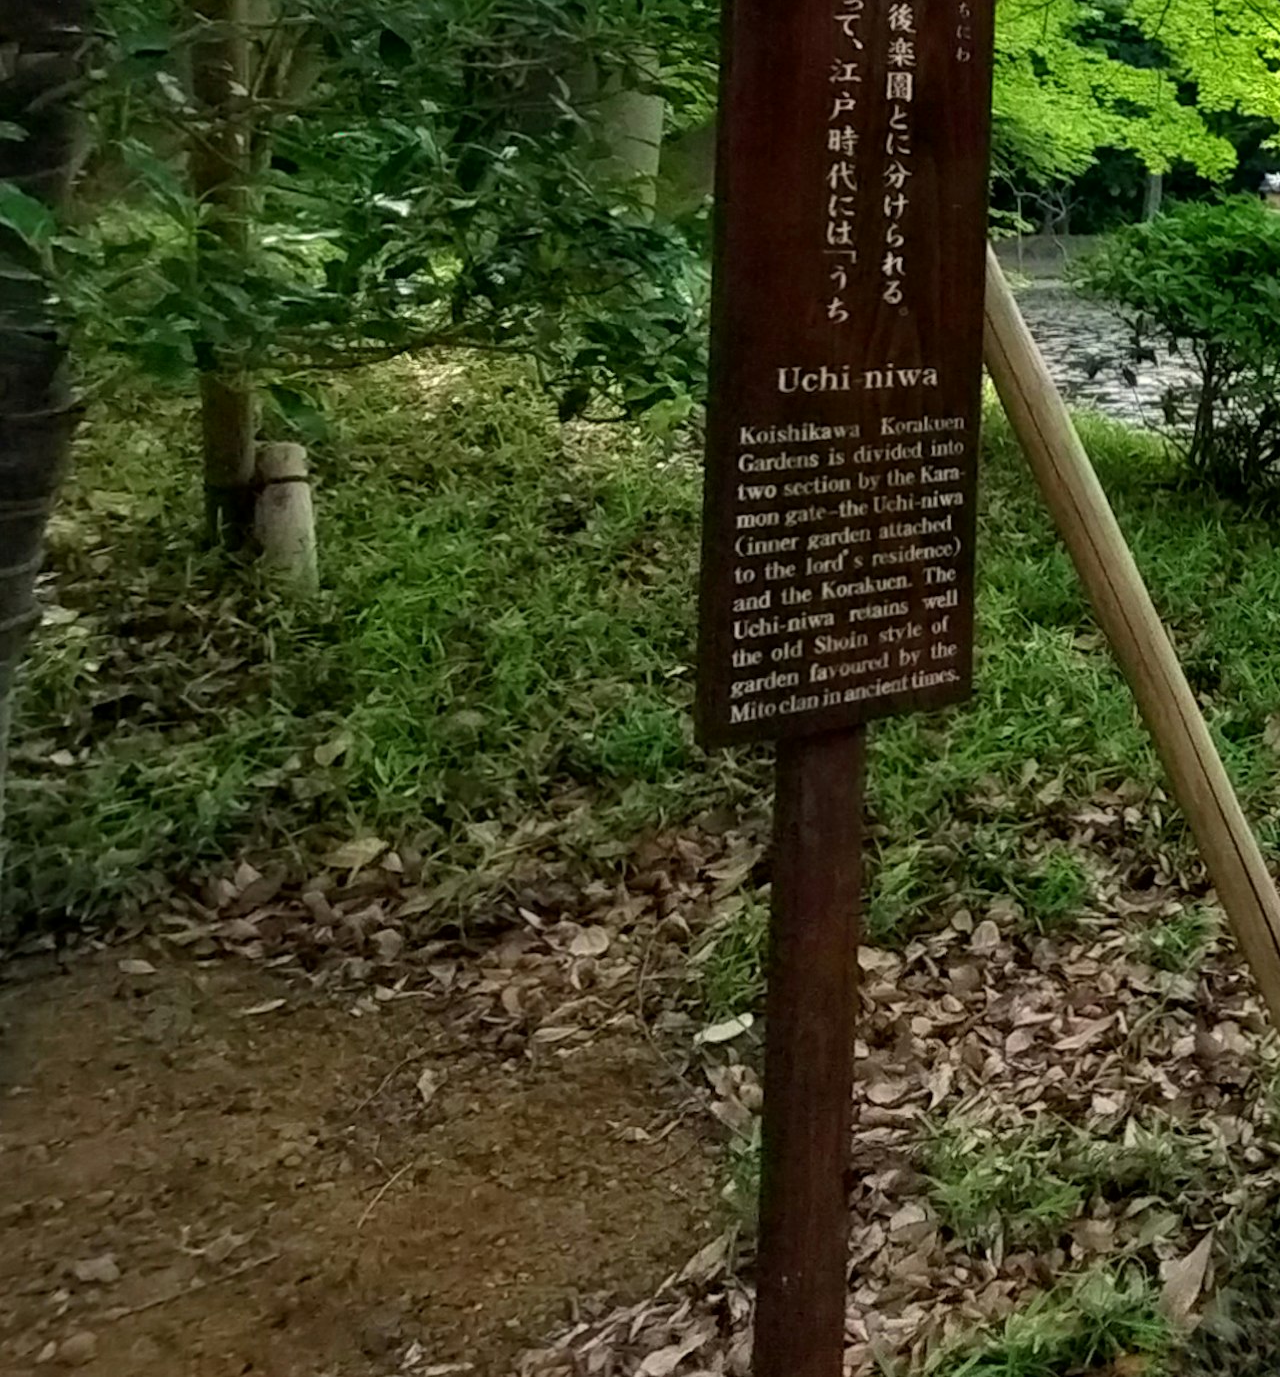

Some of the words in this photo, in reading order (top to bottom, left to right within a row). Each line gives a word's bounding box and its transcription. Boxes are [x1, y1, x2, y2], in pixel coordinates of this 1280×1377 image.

[740, 422, 861, 445] Koishikawa
[880, 415, 965, 436] Korakuen
[738, 451, 820, 473] Gardens
[828, 447, 845, 466] is
[853, 442, 923, 464] divided
[931, 438, 965, 457] into
[737, 483, 777, 501] two
[783, 475, 850, 496] section
[858, 471, 881, 490] by
[886, 468, 915, 487] the
[919, 464, 965, 484] Kara-
[736, 510, 780, 529] mon
[873, 490, 964, 514] Uchi-niwa
[734, 534, 799, 557] (inner
[806, 525, 871, 551] garden
[878, 515, 953, 540] attached
[734, 566, 756, 585] to
[764, 560, 796, 581] the
[871, 536, 962, 567] residence)
[732, 591, 771, 613] and
[781, 585, 812, 606] the
[821, 574, 913, 601] Korakuen.
[923, 566, 957, 586] The
[733, 611, 835, 640] Uchi-niwa
[849, 599, 909, 623] retains
[922, 589, 958, 610] well
[732, 648, 763, 668] the
[770, 639, 804, 662] old
[814, 632, 869, 655] Shoin
[878, 622, 923, 645] style
[931, 615, 950, 635] of
[730, 672, 800, 699] garden
[809, 653, 889, 683] favoured
[899, 648, 922, 668] by
[930, 640, 958, 660] the
[729, 702, 777, 724] Mito
[778, 694, 819, 715] clan
[822, 688, 842, 707] in
[843, 676, 909, 703] ancient
[911, 666, 961, 692] times.
